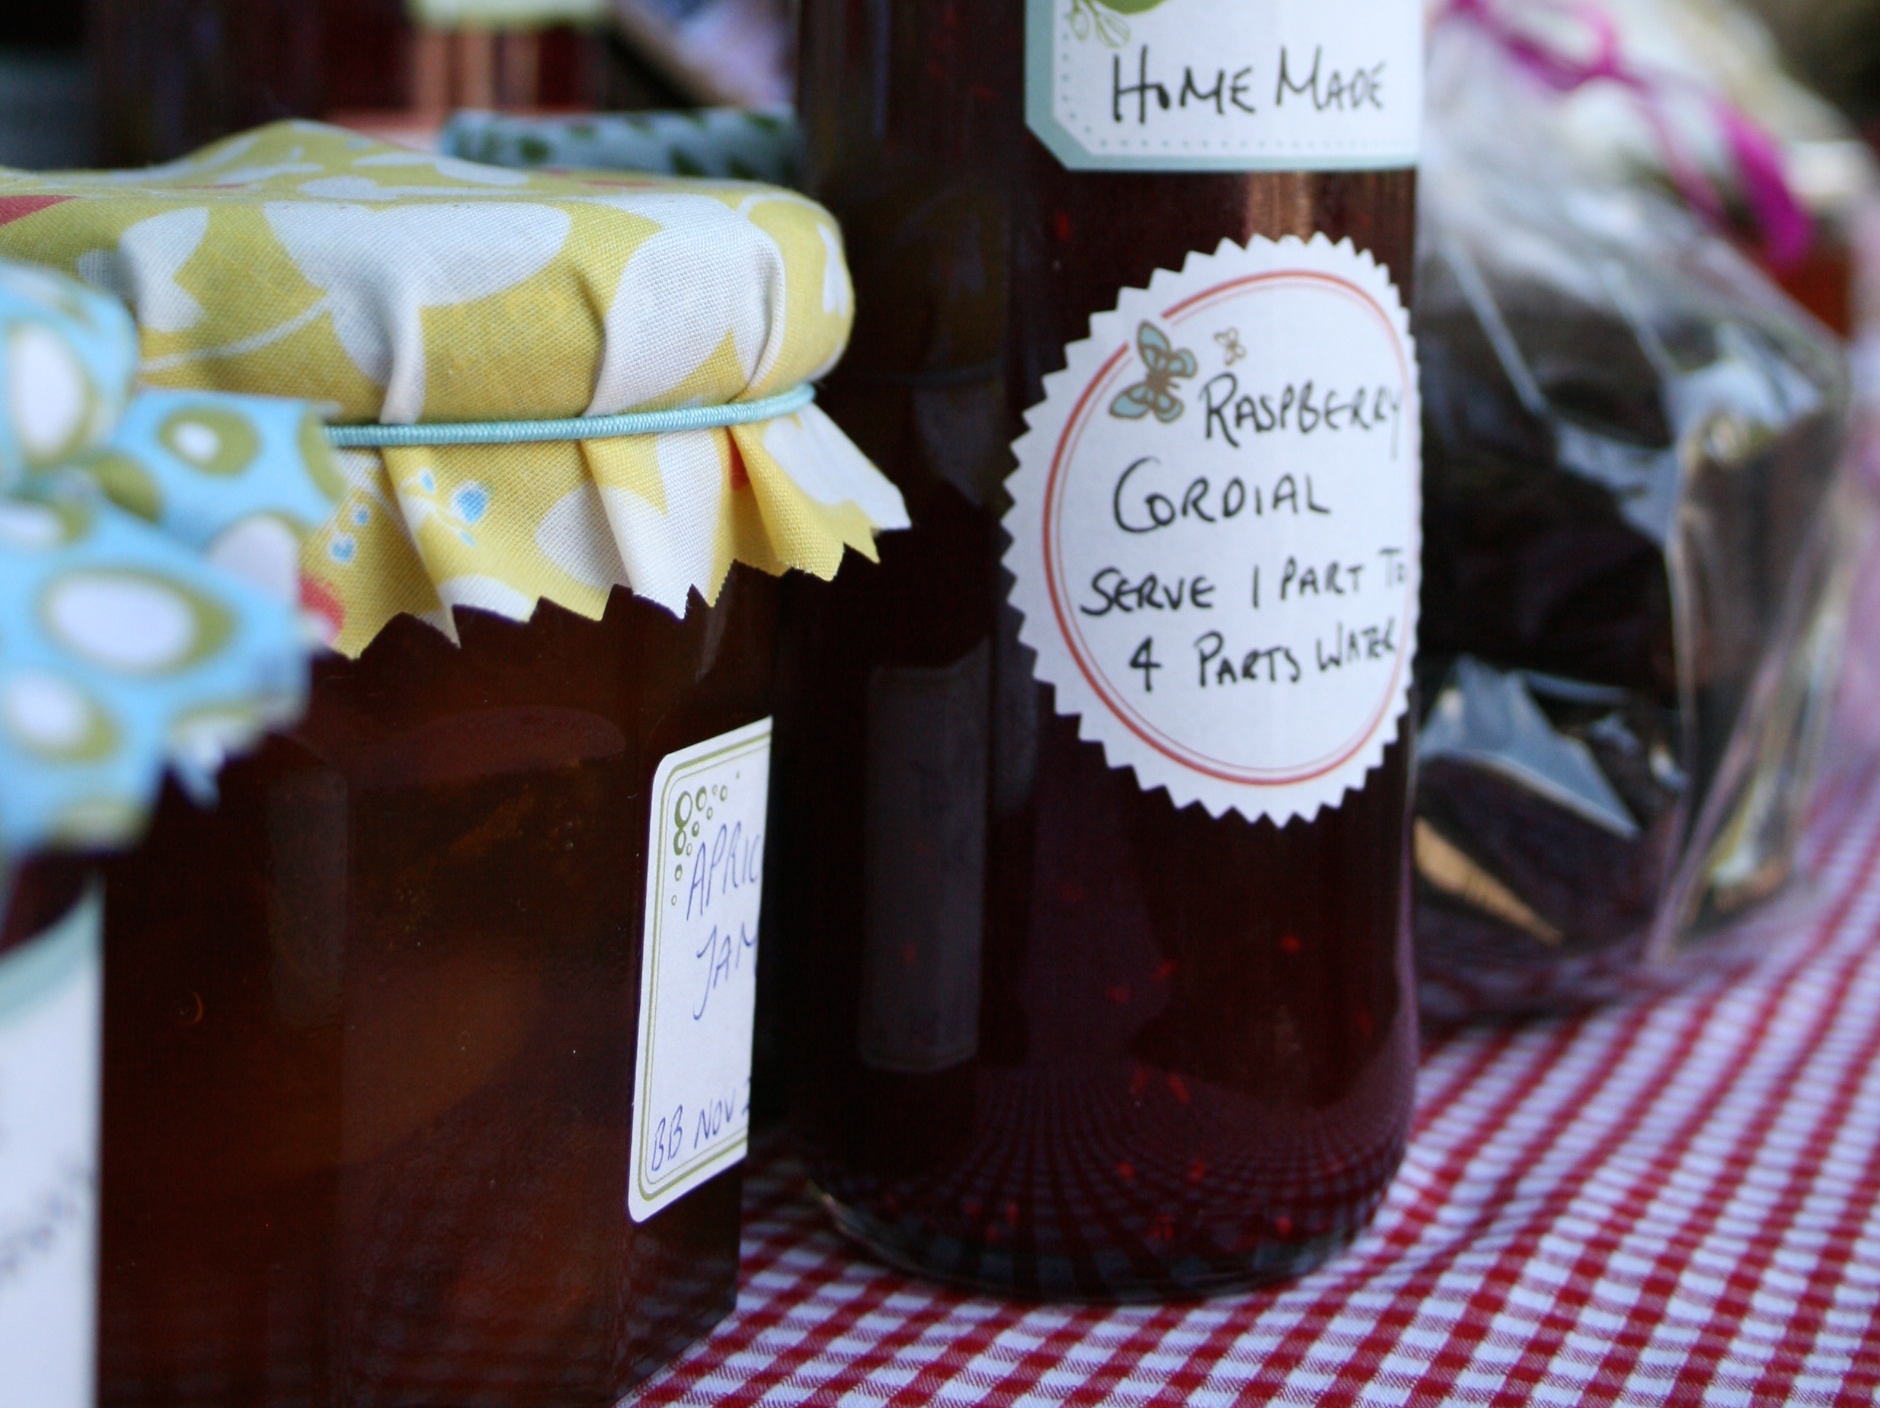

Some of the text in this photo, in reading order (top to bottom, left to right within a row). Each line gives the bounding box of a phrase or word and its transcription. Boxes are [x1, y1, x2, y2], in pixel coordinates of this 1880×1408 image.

[1112, 44, 1386, 124] HOME MADE
[1199, 371, 1401, 461] RASPBERRY
[1114, 458, 1331, 533] CORDIAL
[1080, 567, 1215, 616] SERVE
[1280, 555, 1364, 601] PART
[1129, 616, 1396, 693] 4 PARTS WATER
[651, 1103, 683, 1172] BB
[693, 1088, 737, 1150] NOV
